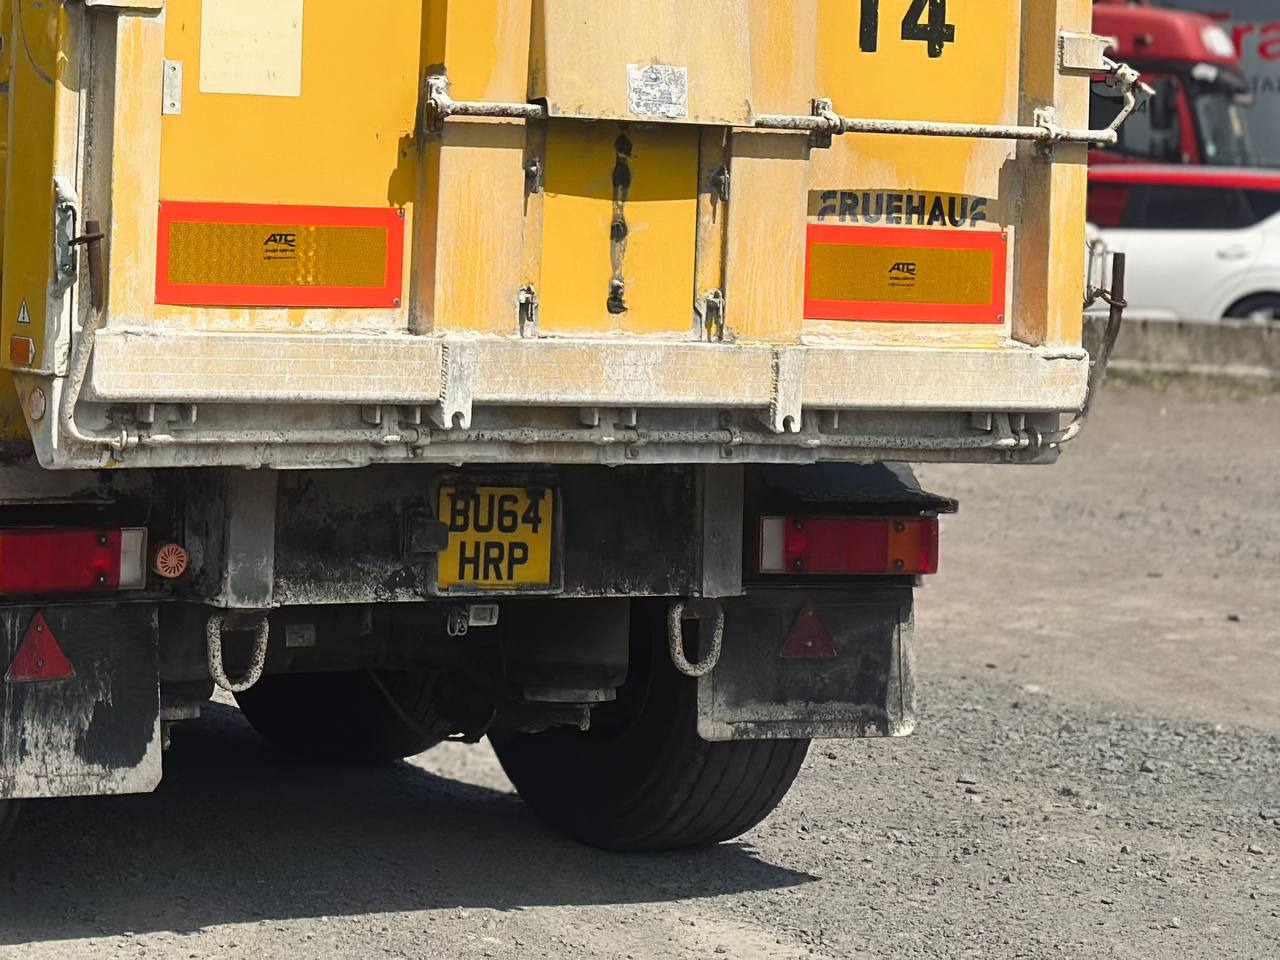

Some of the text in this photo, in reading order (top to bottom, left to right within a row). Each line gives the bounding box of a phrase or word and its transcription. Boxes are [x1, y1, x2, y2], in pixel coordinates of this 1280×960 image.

[263, 233, 296, 247] ATC
[448, 493, 542, 533] BU64
[458, 540, 529, 581] HRP
